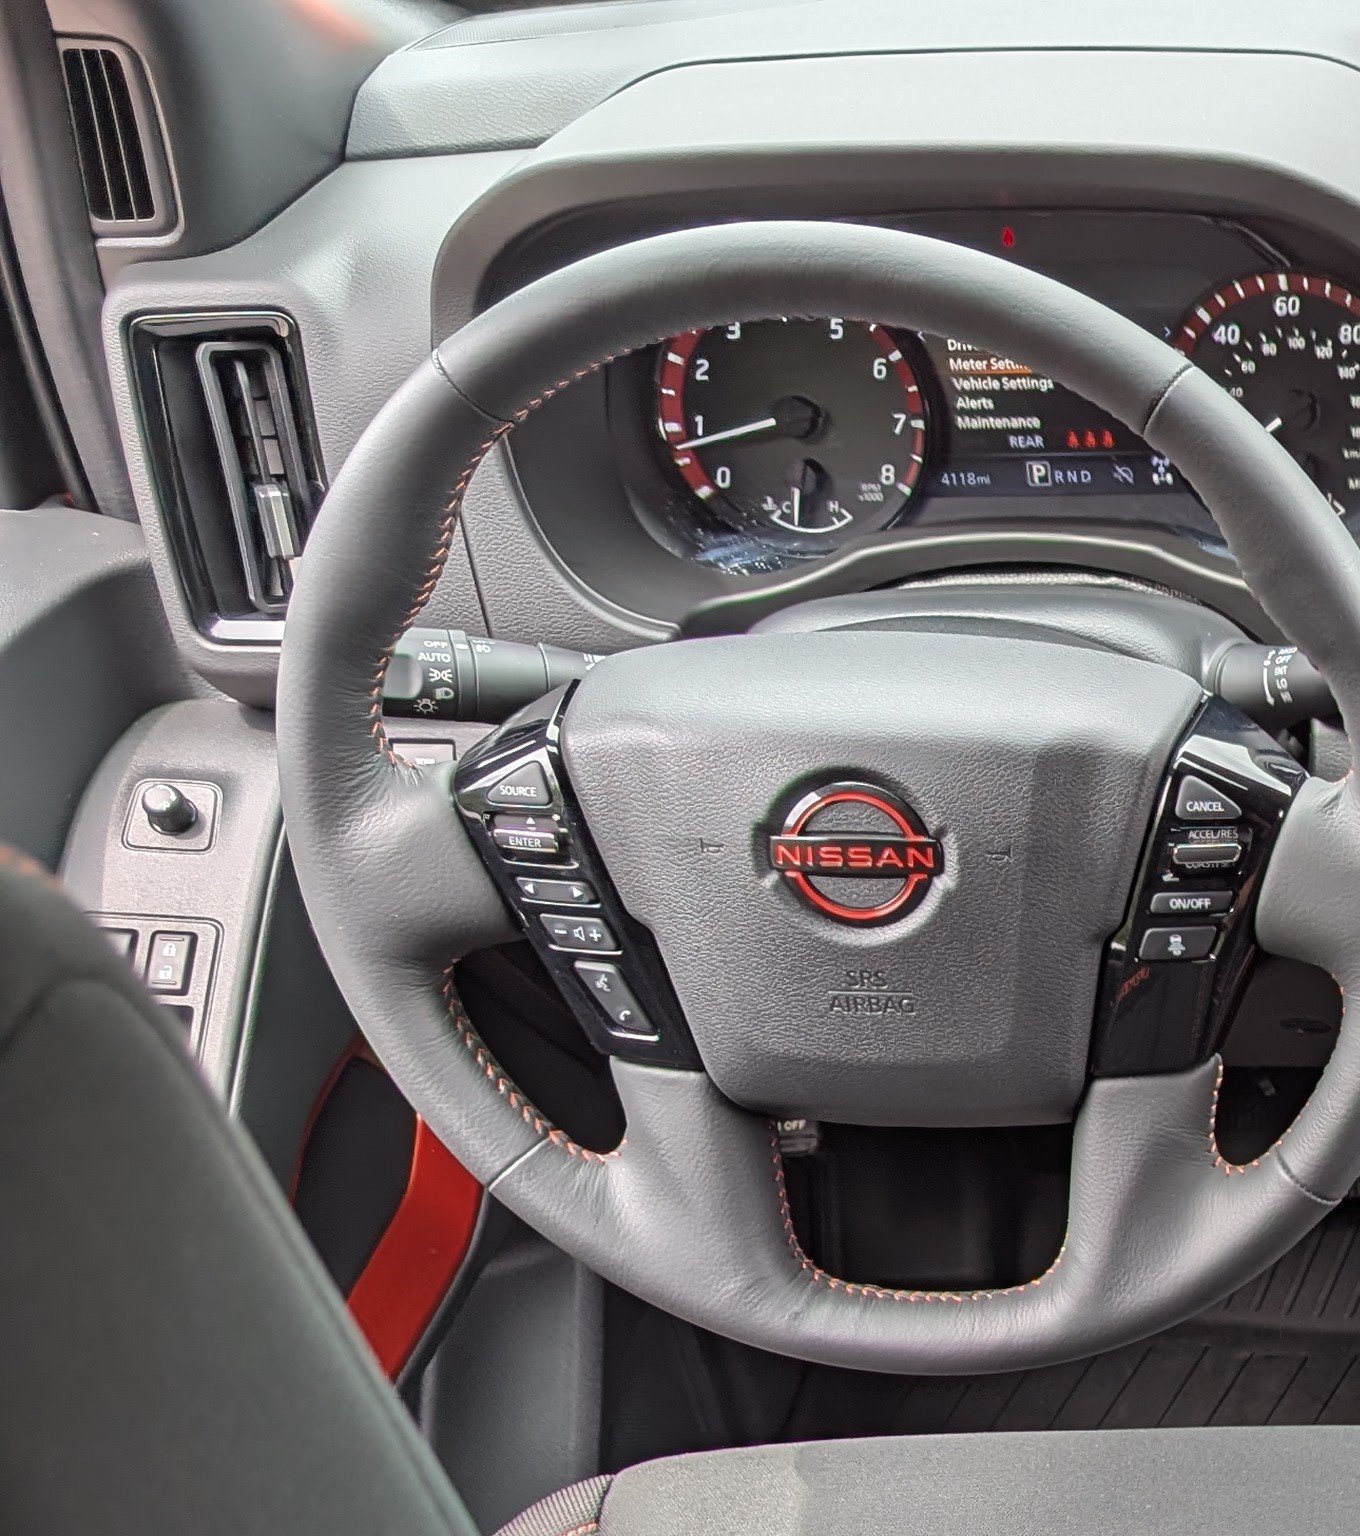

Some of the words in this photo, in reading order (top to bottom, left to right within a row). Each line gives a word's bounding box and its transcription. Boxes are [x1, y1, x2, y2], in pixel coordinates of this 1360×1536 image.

[1273, 295, 1301, 317] 60
[726, 321, 741, 340] 3
[829, 318, 844, 341] 5
[1213, 324, 1241, 345] 40
[695, 359, 710, 382] 2
[873, 358, 887, 380] 6
[949, 358, 987, 372] Meter
[1241, 361, 1256, 374] 60
[951, 376, 1000, 391] Vehicle
[1002, 376, 1054, 393] Settings
[956, 396, 995, 410] Alerts
[694, 415, 704, 437] 1
[892, 413, 906, 435] 7
[955, 415, 1042, 430] Maintenance
[1008, 435, 1045, 448] REAR
[716, 467, 731, 489] 0
[880, 464, 896, 486] 8
[418, 652, 451, 663] AUTO
[1276, 678, 1288, 690] LO
[500, 785, 537, 798] SOURCE
[1186, 801, 1225, 812] CANCEL
[508, 836, 542, 848] ENTER
[775, 844, 935, 869] NISSAN
[1169, 898, 1212, 909] ON/OFF
[845, 969, 889, 989] SRS
[829, 996, 916, 1016] AIRBAG
